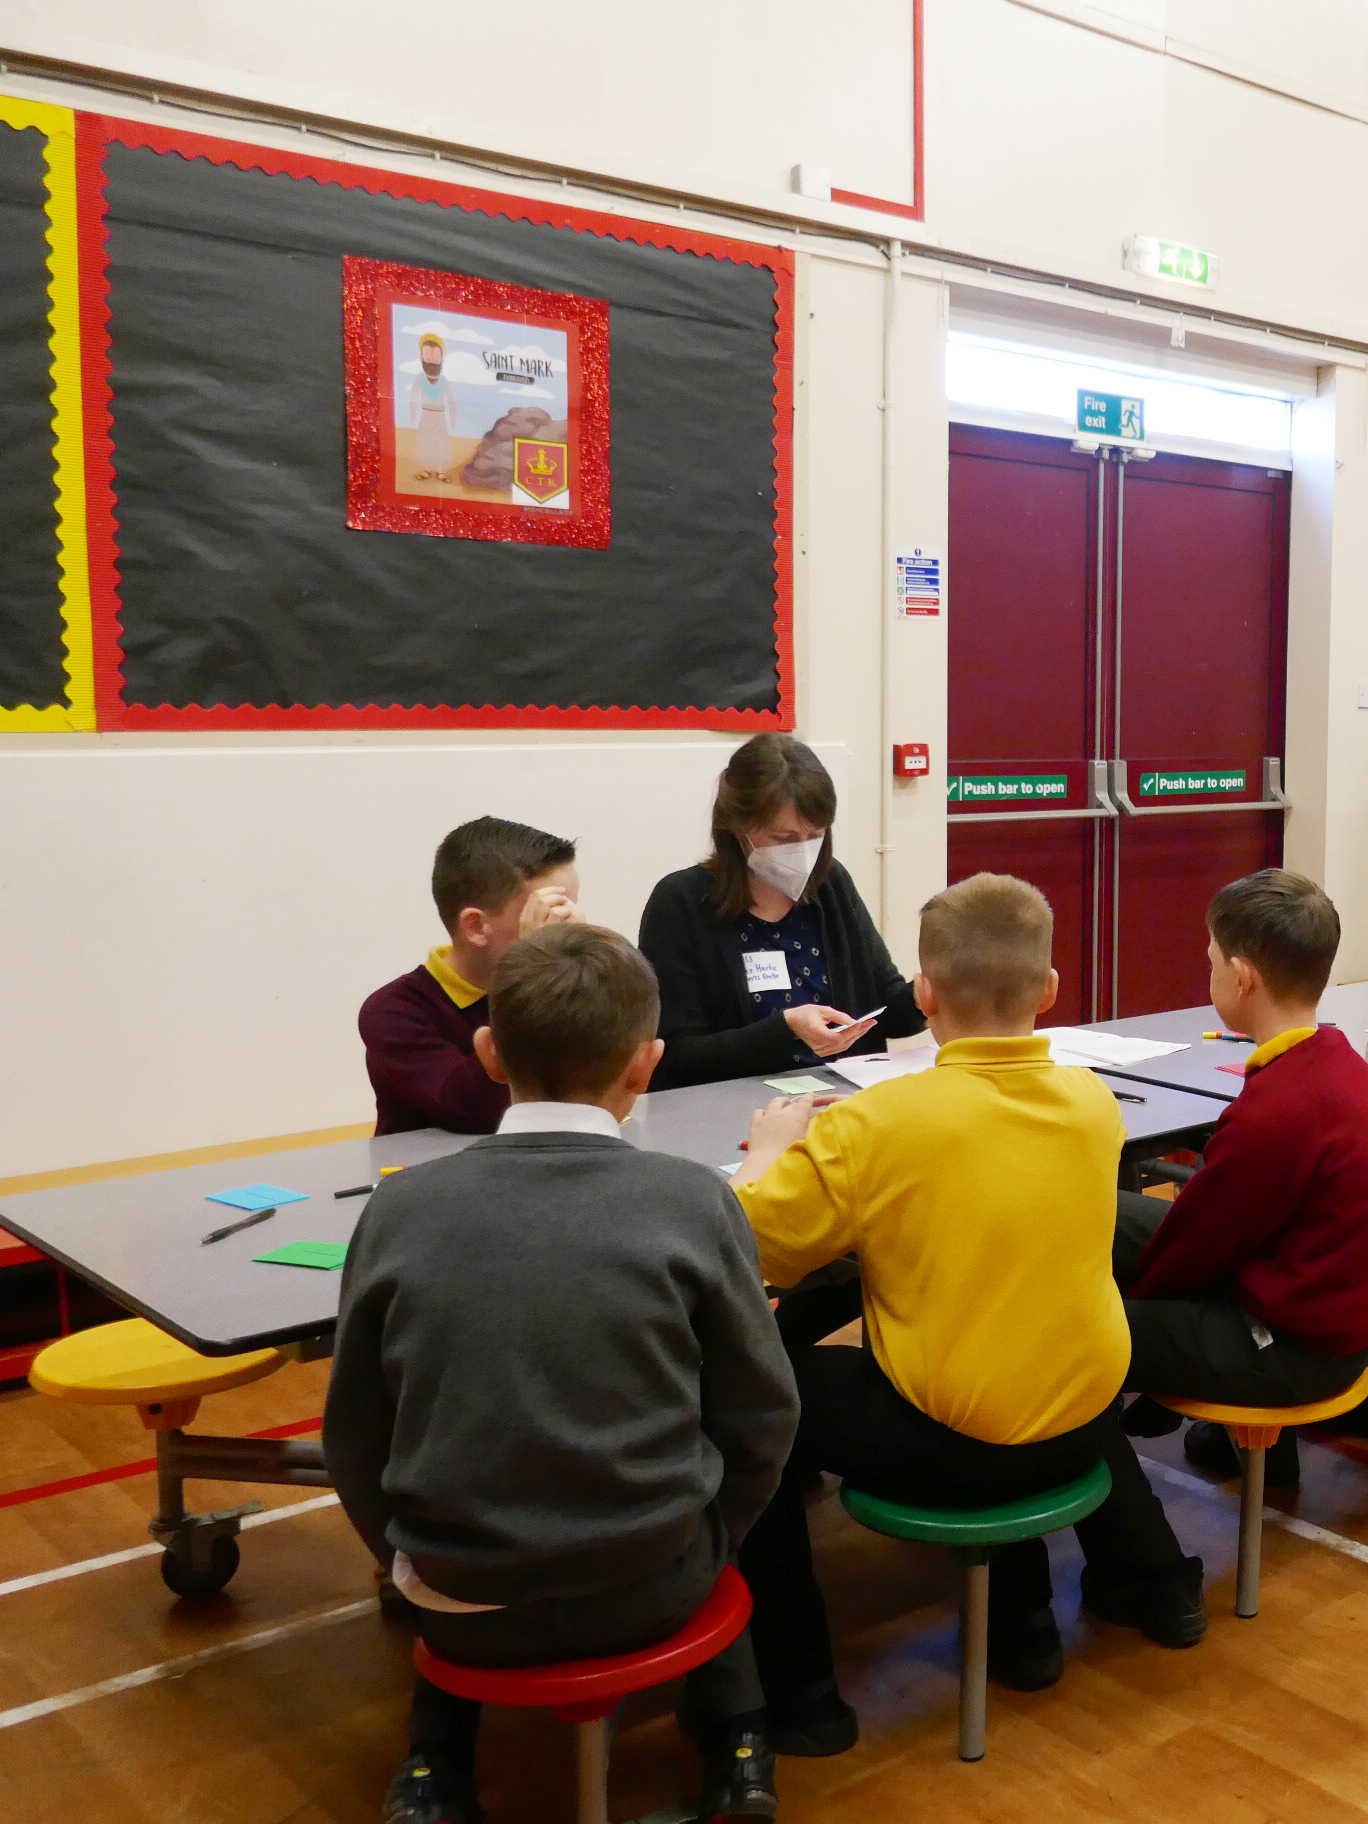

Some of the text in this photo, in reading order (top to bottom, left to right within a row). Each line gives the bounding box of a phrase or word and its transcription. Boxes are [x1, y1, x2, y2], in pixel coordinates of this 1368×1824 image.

[482, 350, 514, 372] SAINT
[519, 358, 554, 378] MARK
[1084, 396, 1107, 413] Fire
[1085, 415, 1107, 429] exit
[964, 781, 1065, 797] Push bar to open
[1159, 777, 1244, 790] Push bar to open
